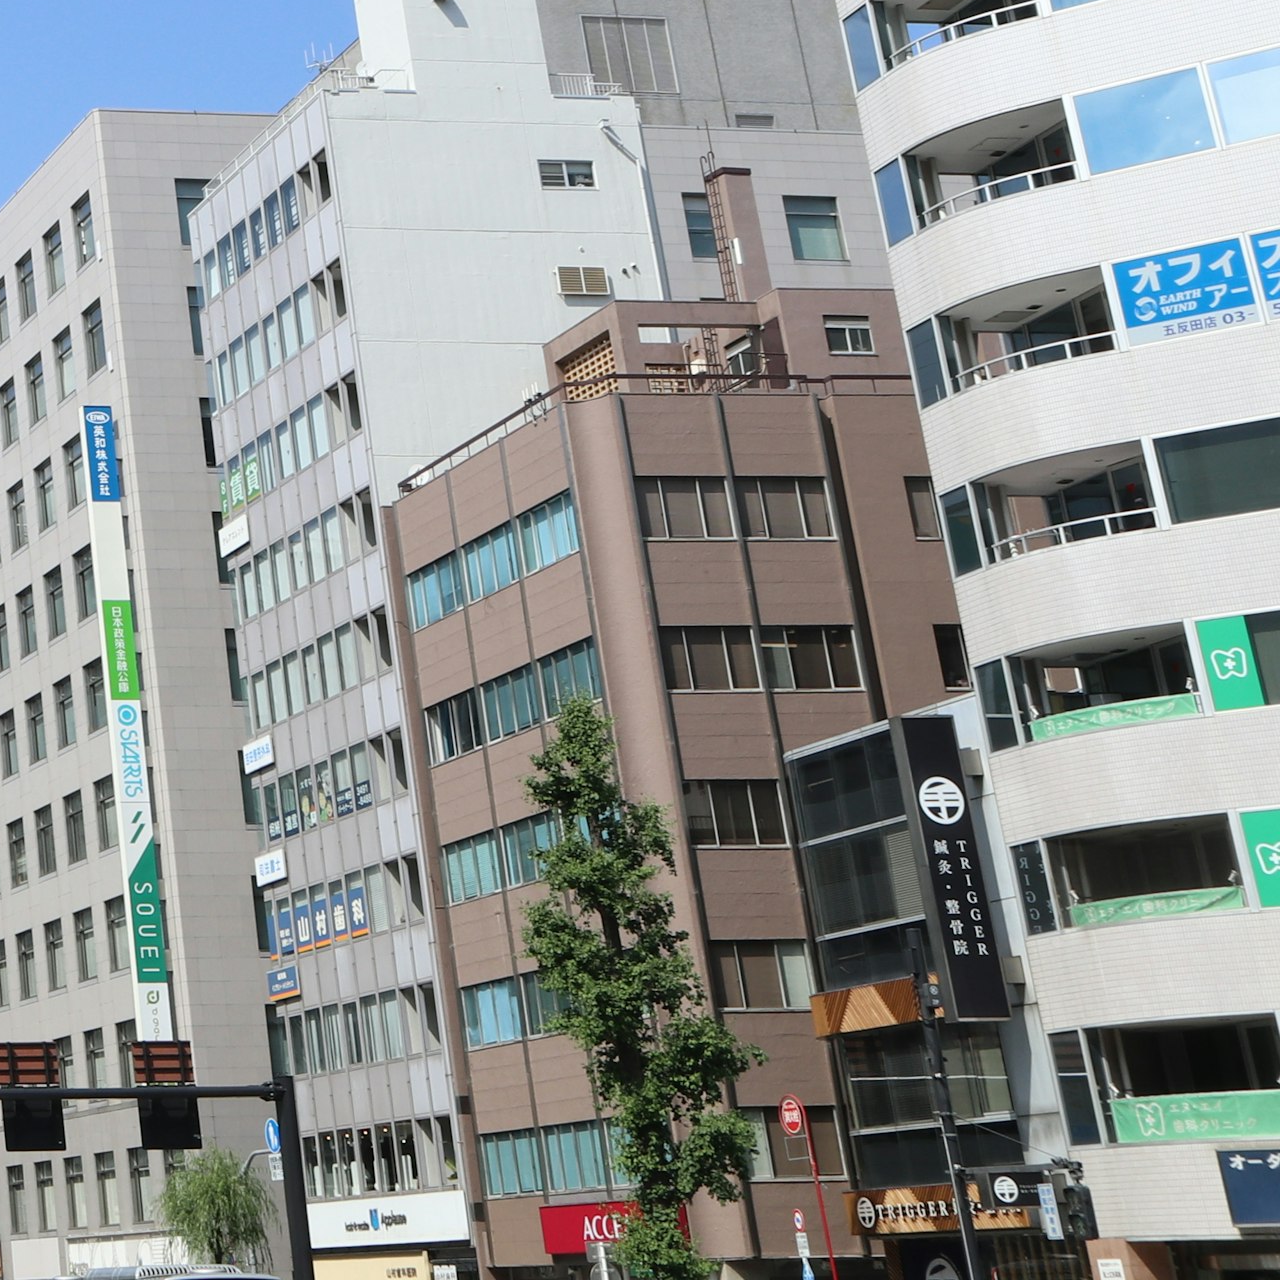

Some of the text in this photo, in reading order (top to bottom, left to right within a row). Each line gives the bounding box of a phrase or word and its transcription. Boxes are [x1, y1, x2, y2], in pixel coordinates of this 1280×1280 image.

[1159, 288, 1202, 306] EARTH
[1160, 301, 1198, 316] WIND
[1162, 315, 1218, 337] 五反田店
[93, 424, 111, 496] 英和株式会社
[111, 605, 130, 694] 日本政策金融公庫
[120, 728, 144, 799] STARTS
[134, 882, 160, 973] SOUEI
[297, 897, 365, 943] 山村歯科
[934, 839, 969, 957] 鍼灸・整骨院
[956, 839, 989, 957] TRIGGER
[875, 1200, 949, 1222] TRIGGER
